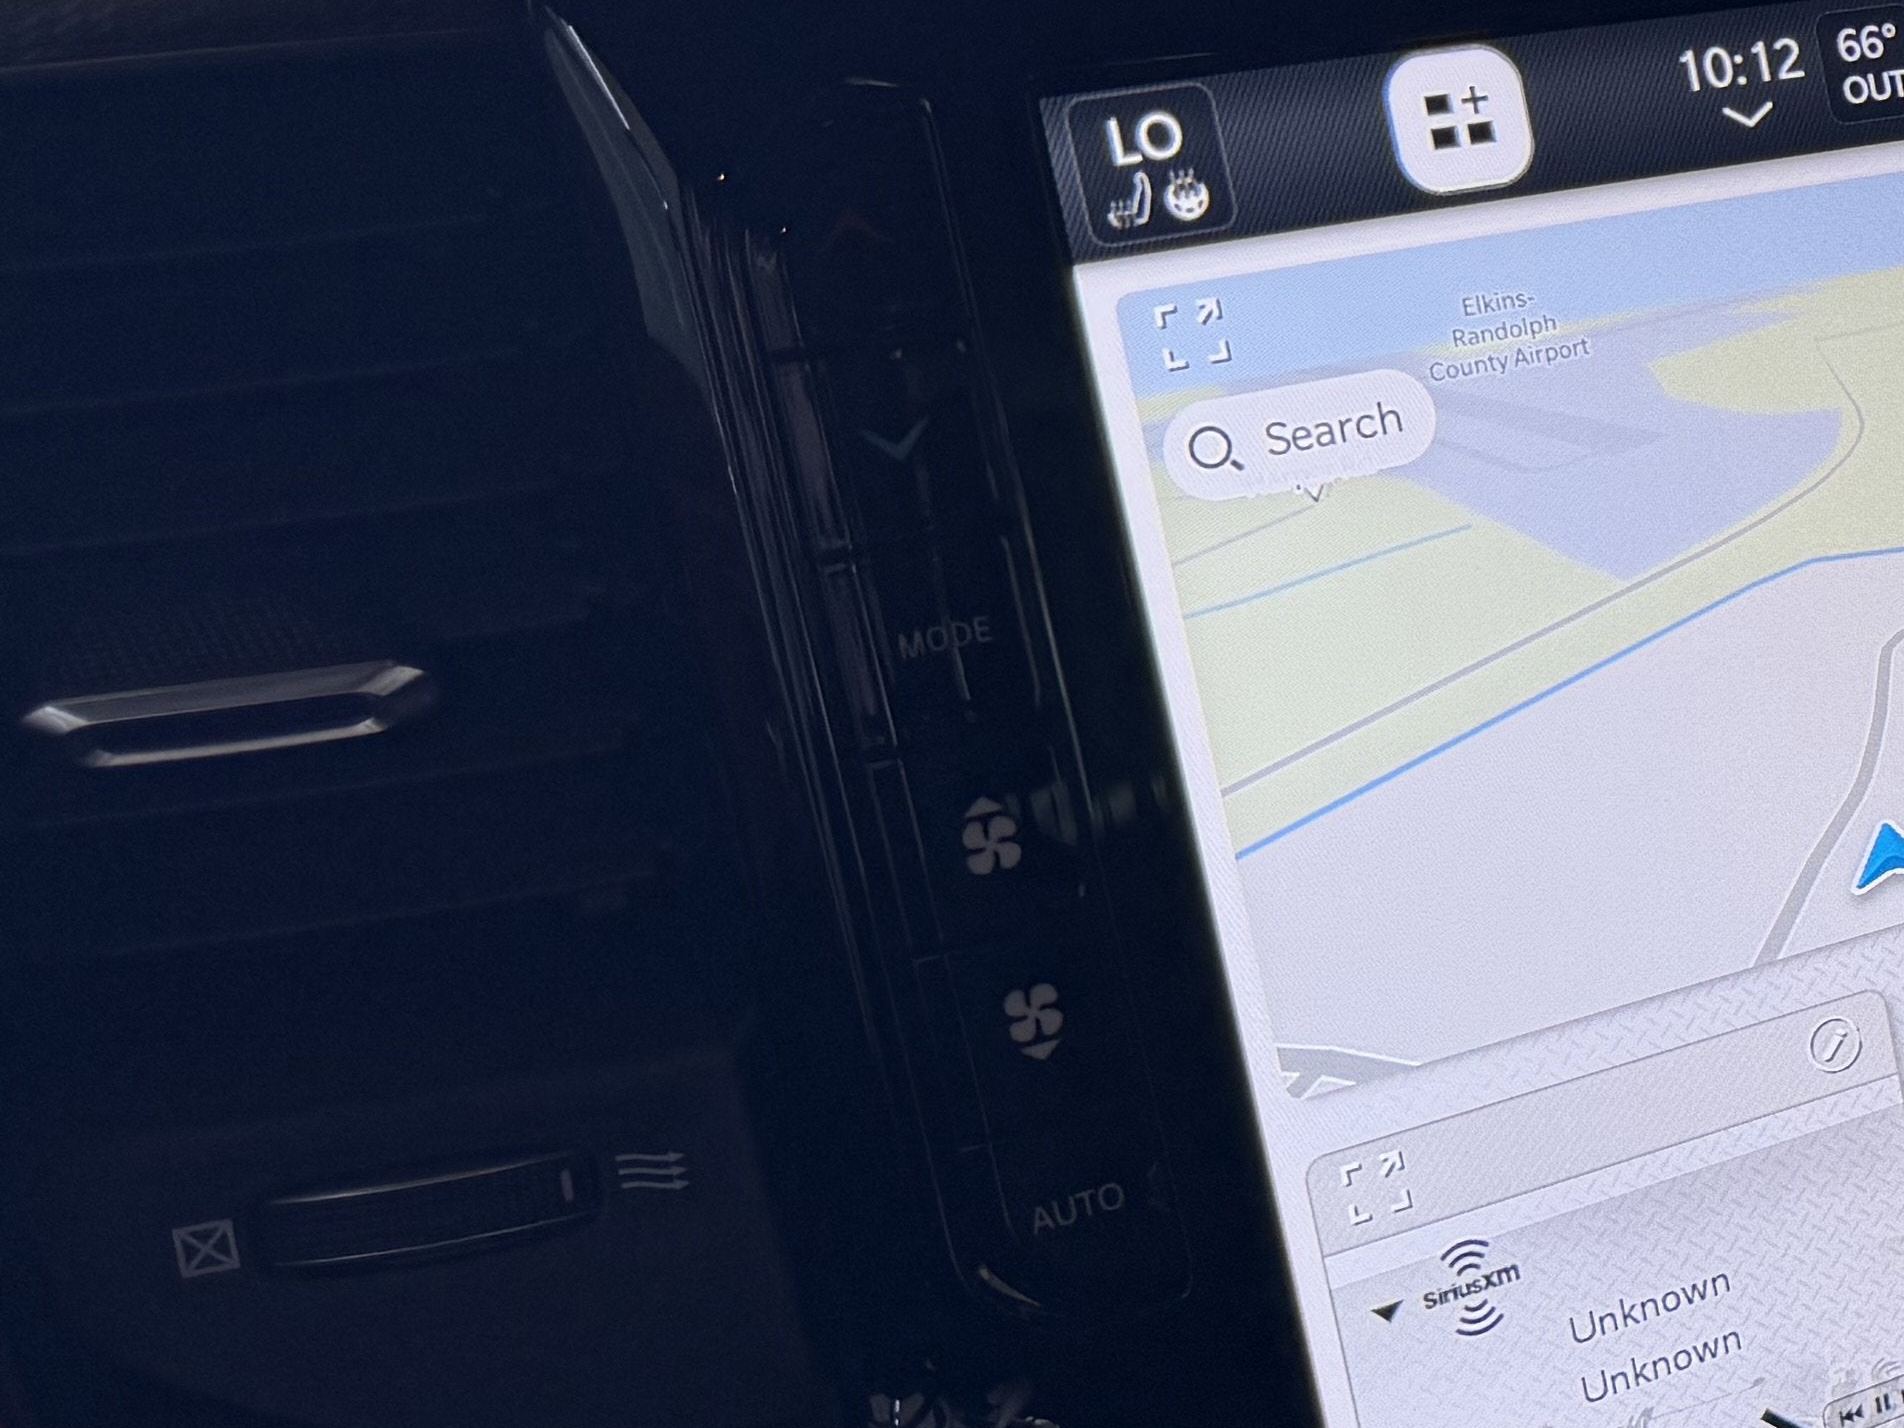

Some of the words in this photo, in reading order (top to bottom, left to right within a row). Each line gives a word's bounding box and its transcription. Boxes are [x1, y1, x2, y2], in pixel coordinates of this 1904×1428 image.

[1680, 37, 1805, 92] 10:12
[1836, 22, 1897, 64] 66°
[1105, 110, 1182, 167] LO
[1451, 313, 1558, 349] Randolph
[1462, 292, 1535, 318] Elkins-
[1429, 352, 1510, 384] County
[1513, 336, 1590, 371] Airport
[1264, 401, 1404, 456] Search
[897, 615, 993, 663] MODE
[1031, 1182, 1126, 1235] AUTO
[1568, 1271, 1732, 1345] Unknown
[1580, 1327, 1743, 1404] Unknown
